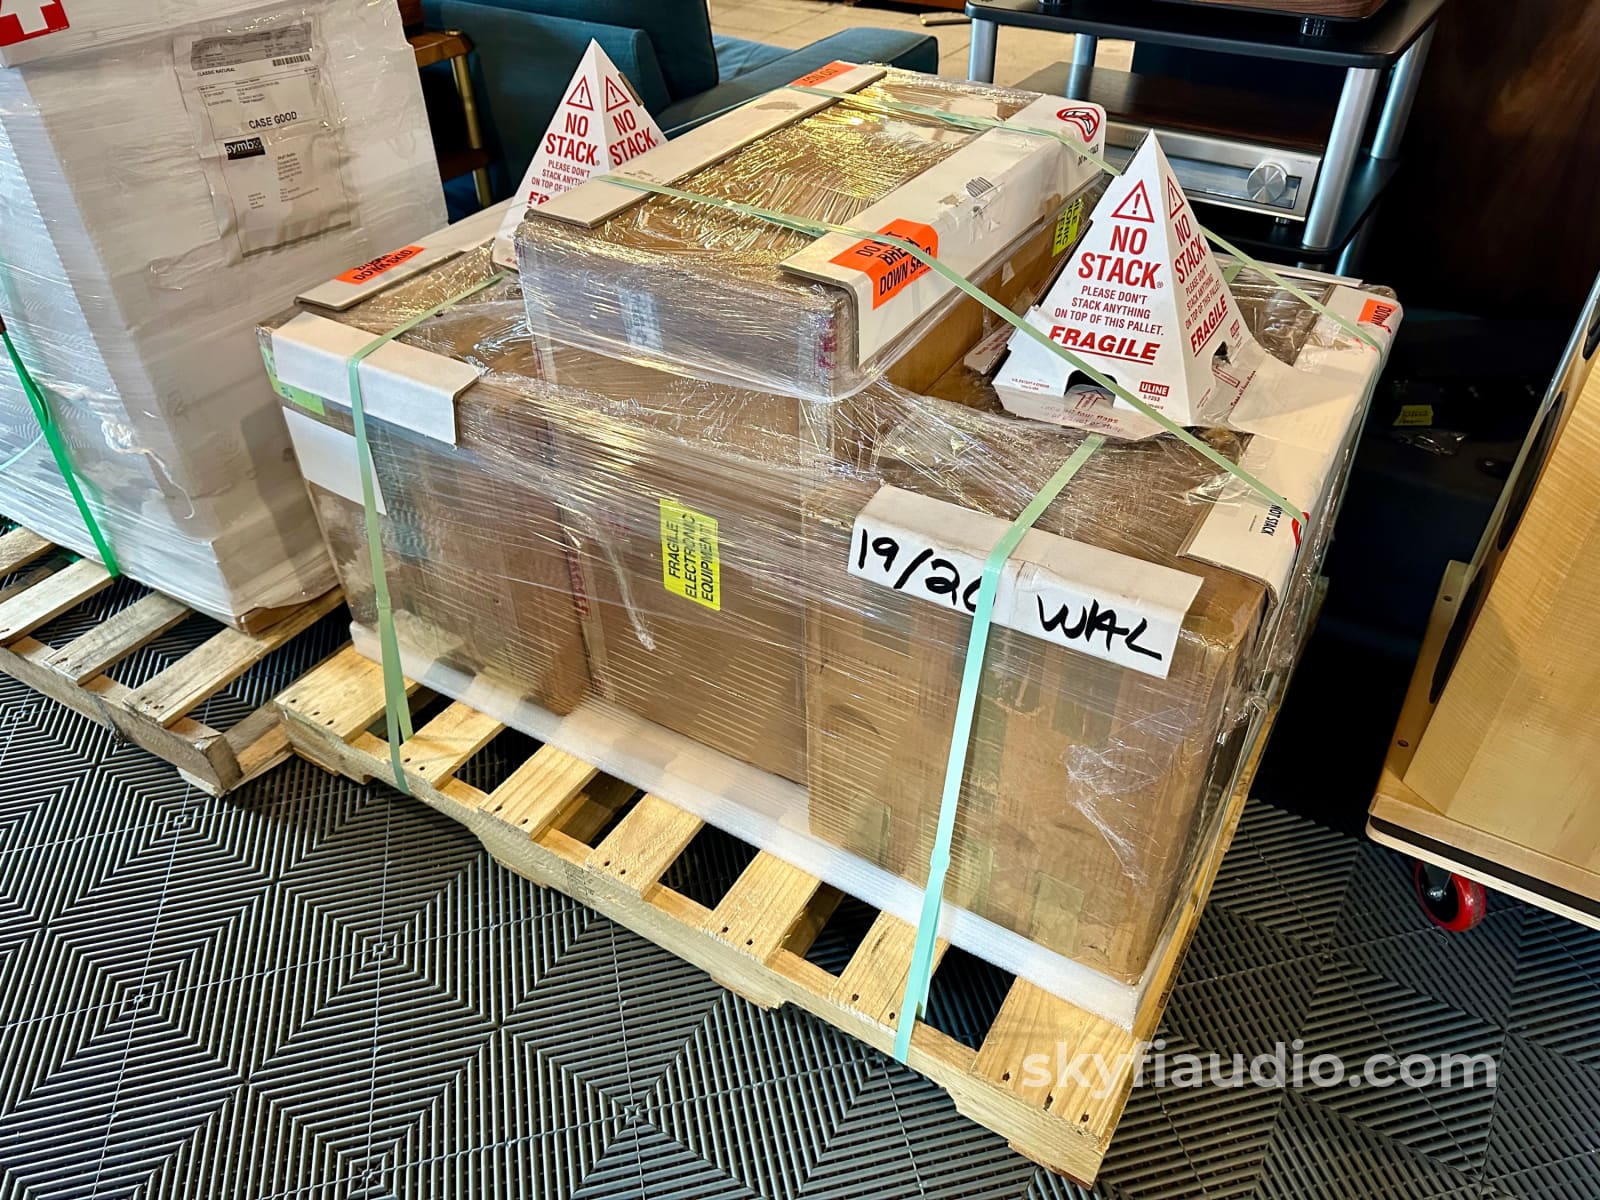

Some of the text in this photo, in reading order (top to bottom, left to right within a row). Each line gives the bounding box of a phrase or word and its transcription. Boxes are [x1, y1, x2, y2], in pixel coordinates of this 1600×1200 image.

[248, 111, 298, 129] CASE GOOD
[565, 112, 590, 138] NO
[612, 109, 637, 136] NO
[542, 169, 562, 181] STACK
[548, 160, 591, 178] PLEASE DON'T
[531, 177, 540, 186] ON
[541, 179, 553, 190] TOP
[554, 184, 563, 192] OF
[1109, 225, 1148, 255] NO
[1175, 214, 1191, 247] NO
[880, 261, 908, 296] DOWN
[1071, 297, 1151, 320] STACK ANYTHING
[1081, 285, 1148, 305] PLEASE DON'T
[1054, 308, 1164, 336] ON TOP OF THIS PALLET.
[1191, 293, 1227, 353] FRAGILE
[1048, 325, 1161, 361] FRAGILE
[1141, 382, 1168, 396] ULINE
[1261, 517, 1279, 536] STACK
[665, 521, 680, 579] FRAGILE
[681, 513, 698, 599] ELECTRONIC
[699, 523, 714, 602] EQUIPMENT
